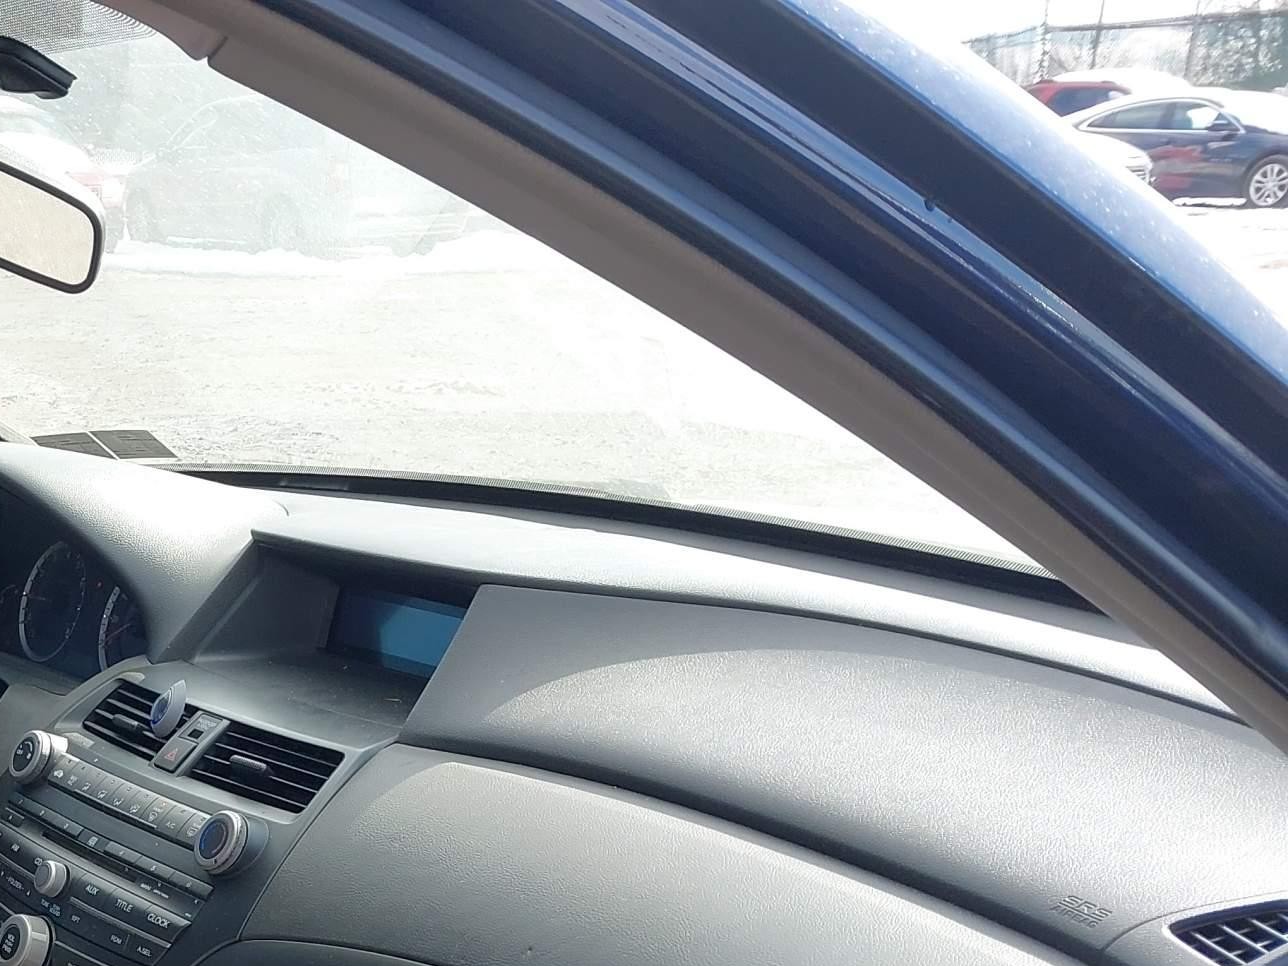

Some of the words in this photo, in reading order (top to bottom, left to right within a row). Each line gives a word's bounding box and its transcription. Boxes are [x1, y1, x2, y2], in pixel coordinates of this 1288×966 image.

[85, 884, 100, 896] AUX
[116, 898, 133, 913] TITLE
[1061, 895, 1113, 919] SRS
[147, 913, 171, 929] CLOCK
